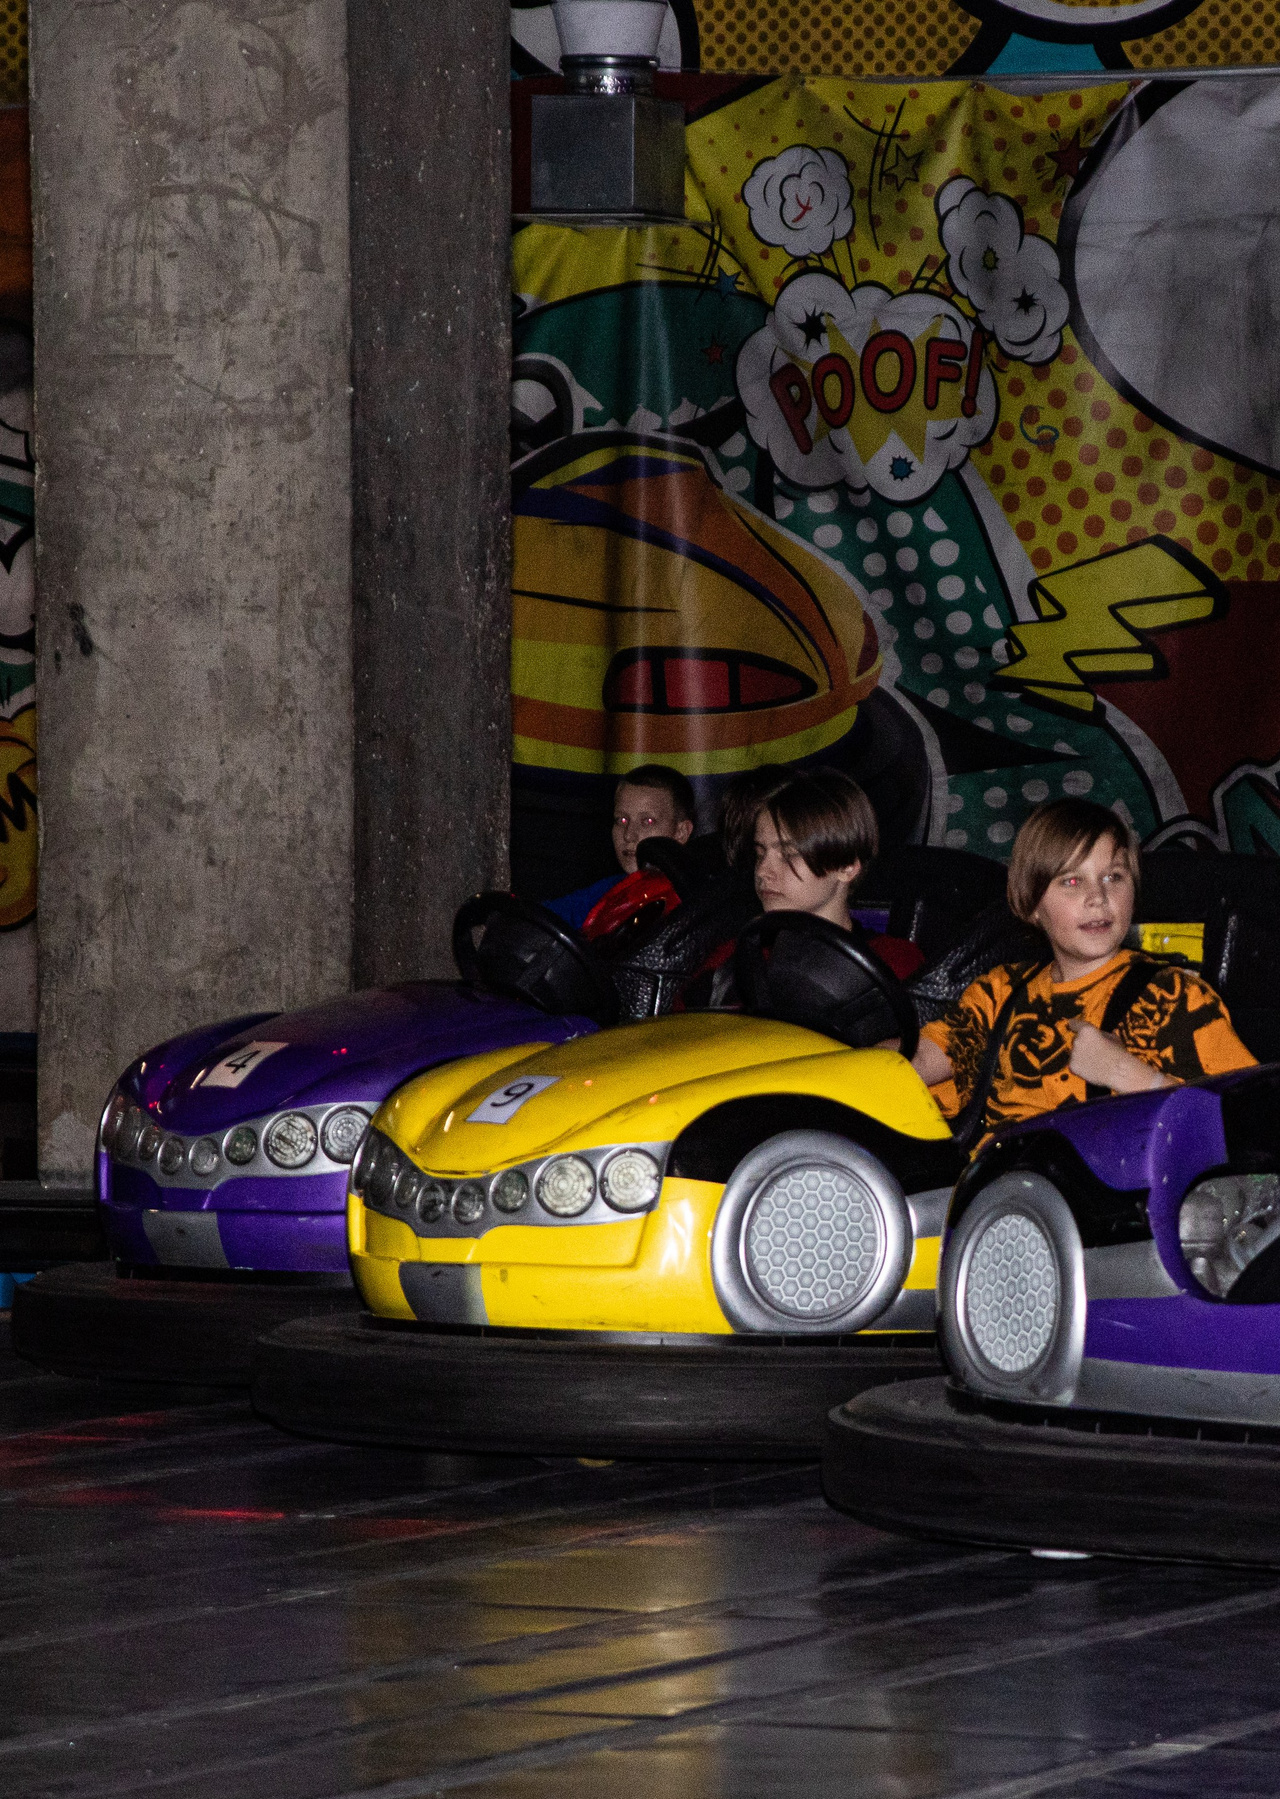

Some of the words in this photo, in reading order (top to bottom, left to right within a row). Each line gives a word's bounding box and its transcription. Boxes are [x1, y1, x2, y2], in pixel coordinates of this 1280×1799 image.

[769, 327, 984, 455] POOF!
[225, 1050, 261, 1074] 4
[490, 1083, 534, 1107] 9
